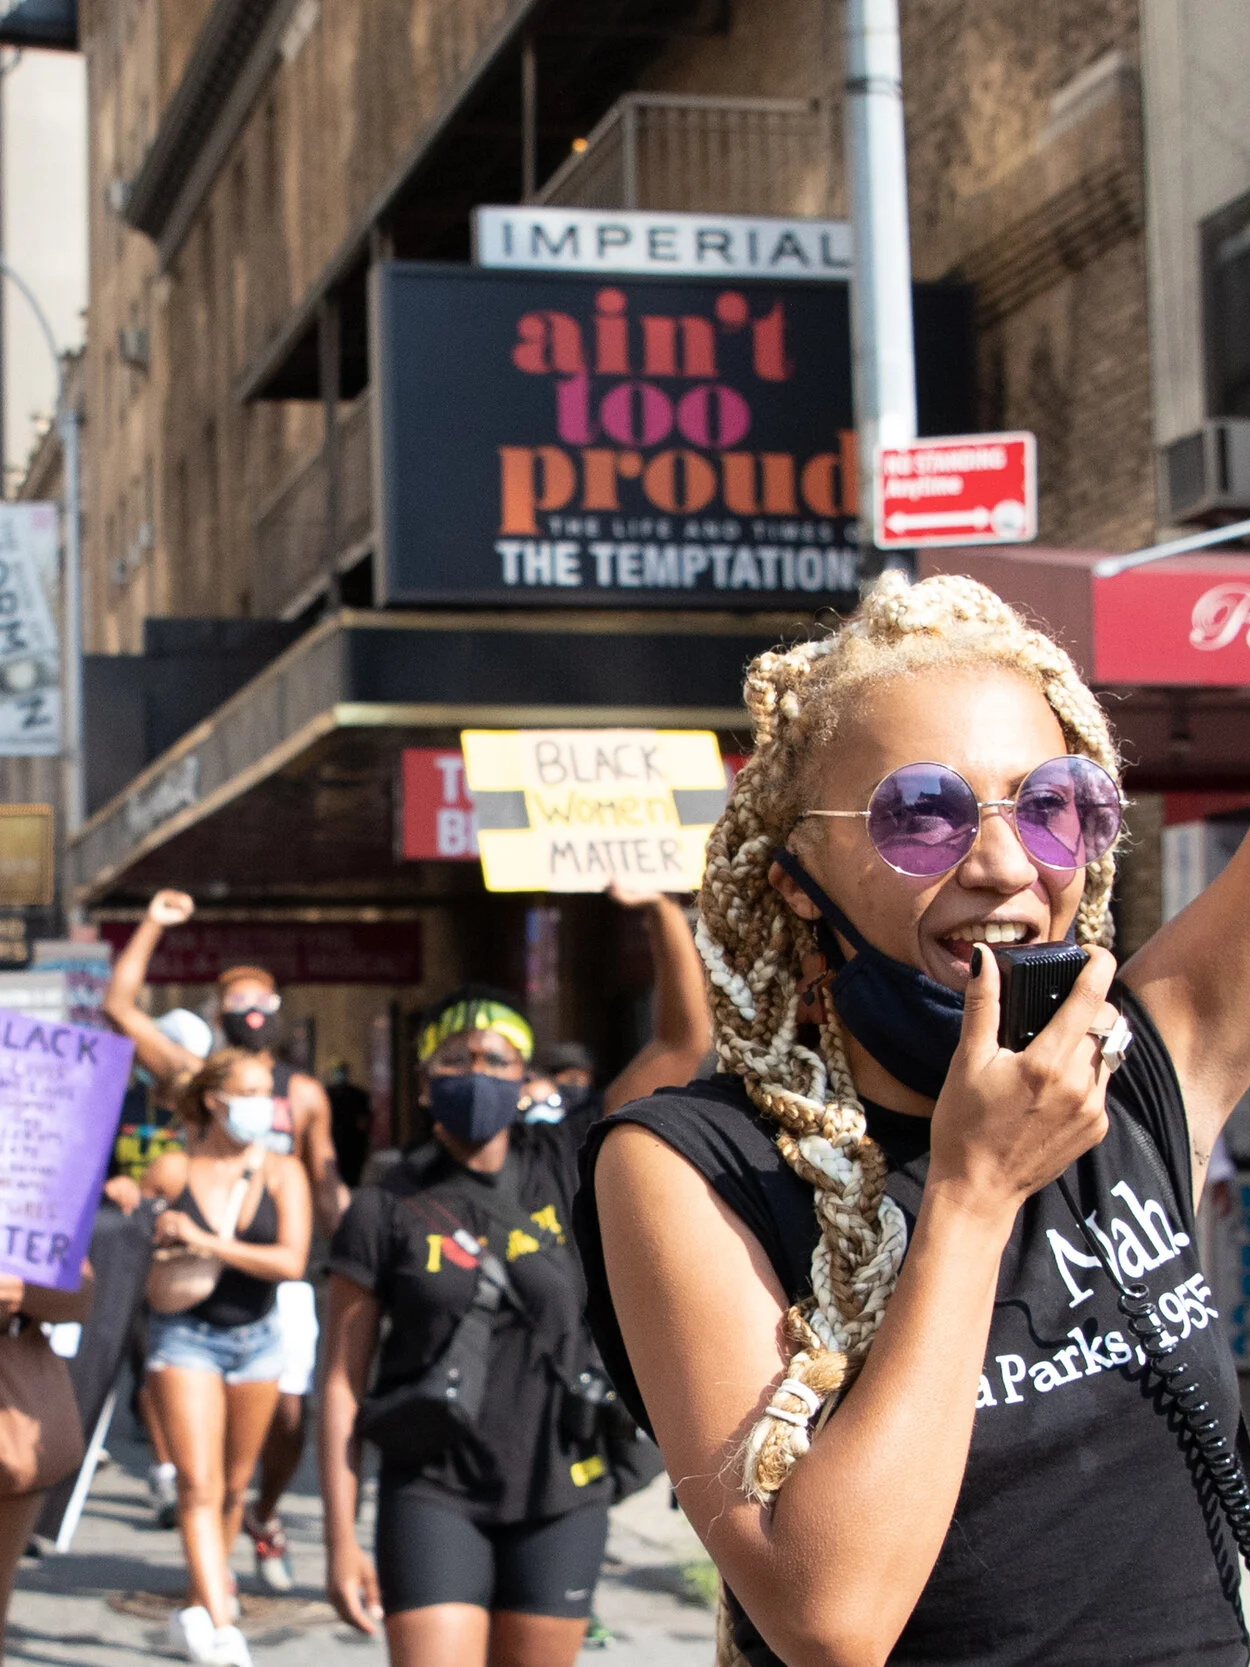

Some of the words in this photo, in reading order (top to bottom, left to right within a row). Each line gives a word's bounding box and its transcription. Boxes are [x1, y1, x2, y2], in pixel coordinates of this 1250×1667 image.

[503, 222, 853, 268] IMPERIAL
[512, 288, 794, 382] ain't
[556, 368, 752, 450] too
[497, 428, 860, 535] proud
[549, 515, 600, 538] THE
[682, 520, 743, 542] AND
[495, 538, 582, 586] THE
[588, 542, 861, 592] TEMPTATION
[535, 740, 668, 785] BLACK
[550, 838, 684, 875] MATTER
[3, 1021, 99, 1064] LACK
[1046, 1180, 1190, 1308] Nah.
